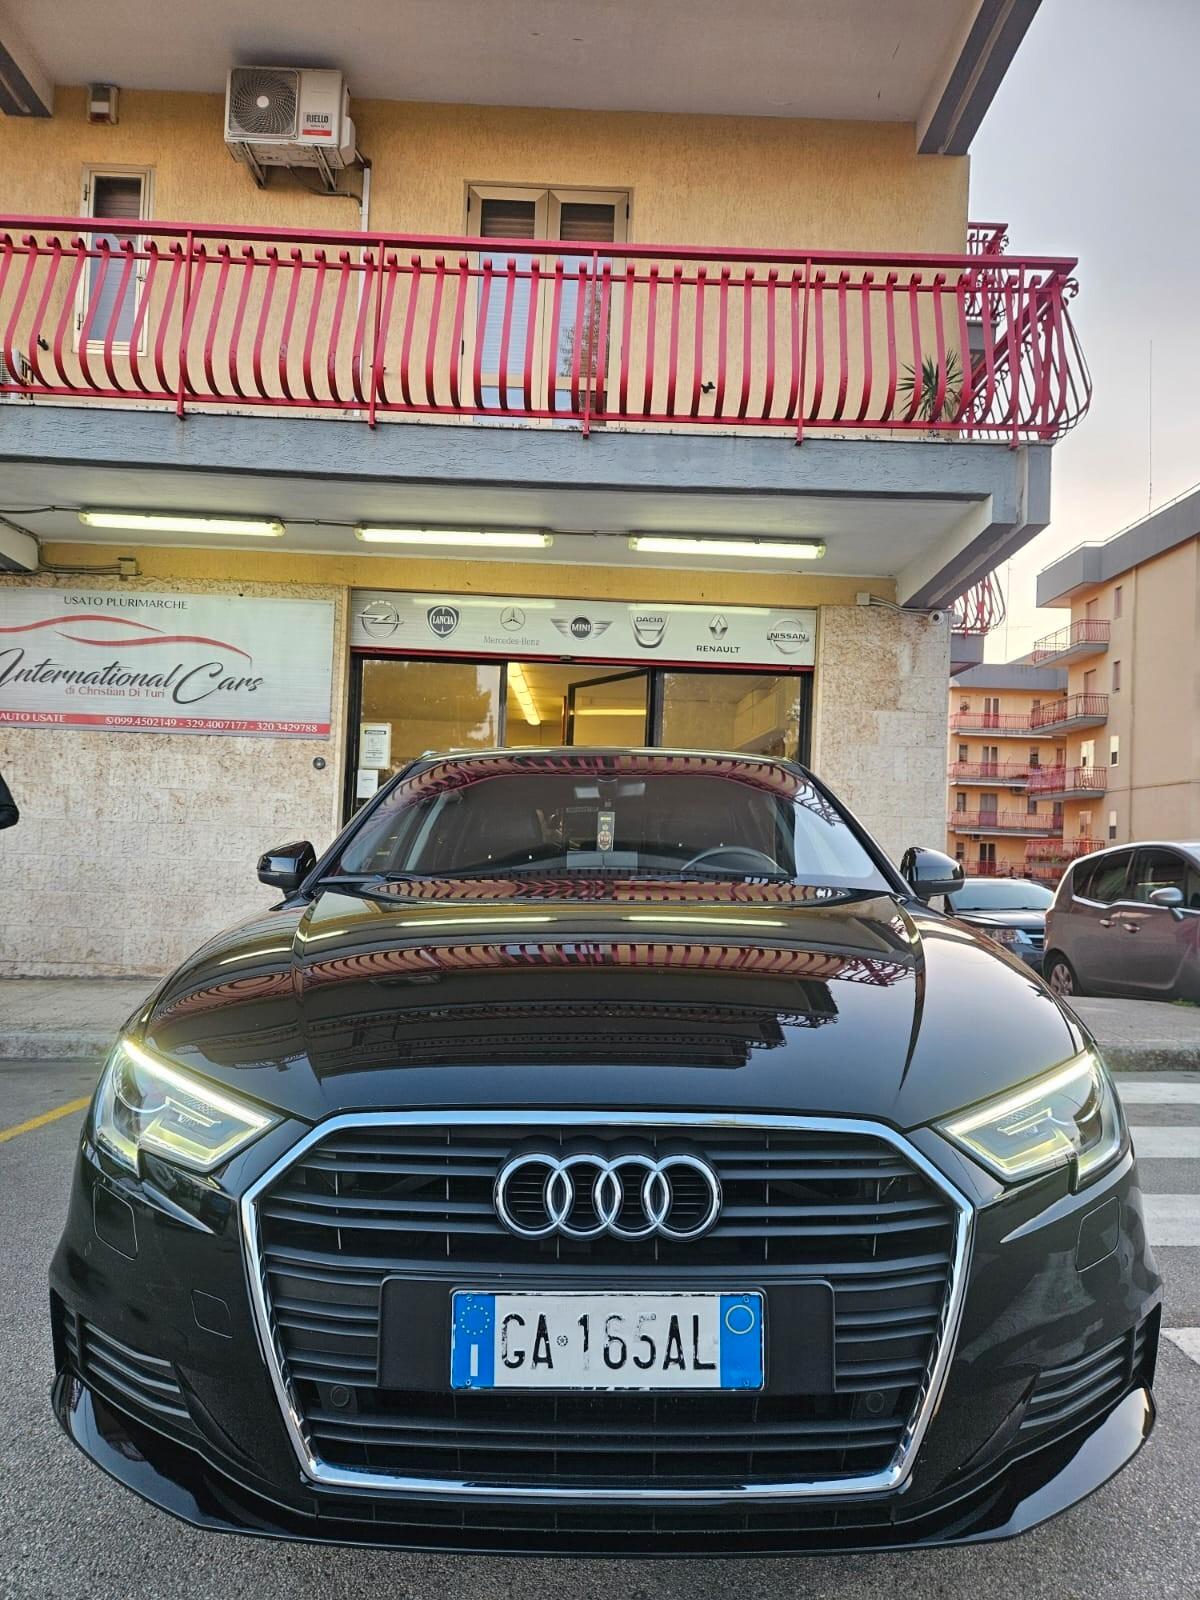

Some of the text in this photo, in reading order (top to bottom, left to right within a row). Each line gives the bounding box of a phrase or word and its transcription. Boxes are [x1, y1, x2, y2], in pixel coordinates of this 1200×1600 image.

[63, 595, 189, 610] USATO PLURIMARCHE
[432, 615, 454, 625] LANCIA
[635, 616, 664, 624] DACIA
[571, 623, 592, 632] MINI
[483, 635, 540, 647] Mercedes-Benz
[770, 632, 807, 640] NISSAN
[696, 645, 741, 654] RENAULT
[0, 648, 264, 704] International Cars
[65, 685, 165, 698] di Christian Di Turi
[0, 712, 66, 723] AUTO USATE
